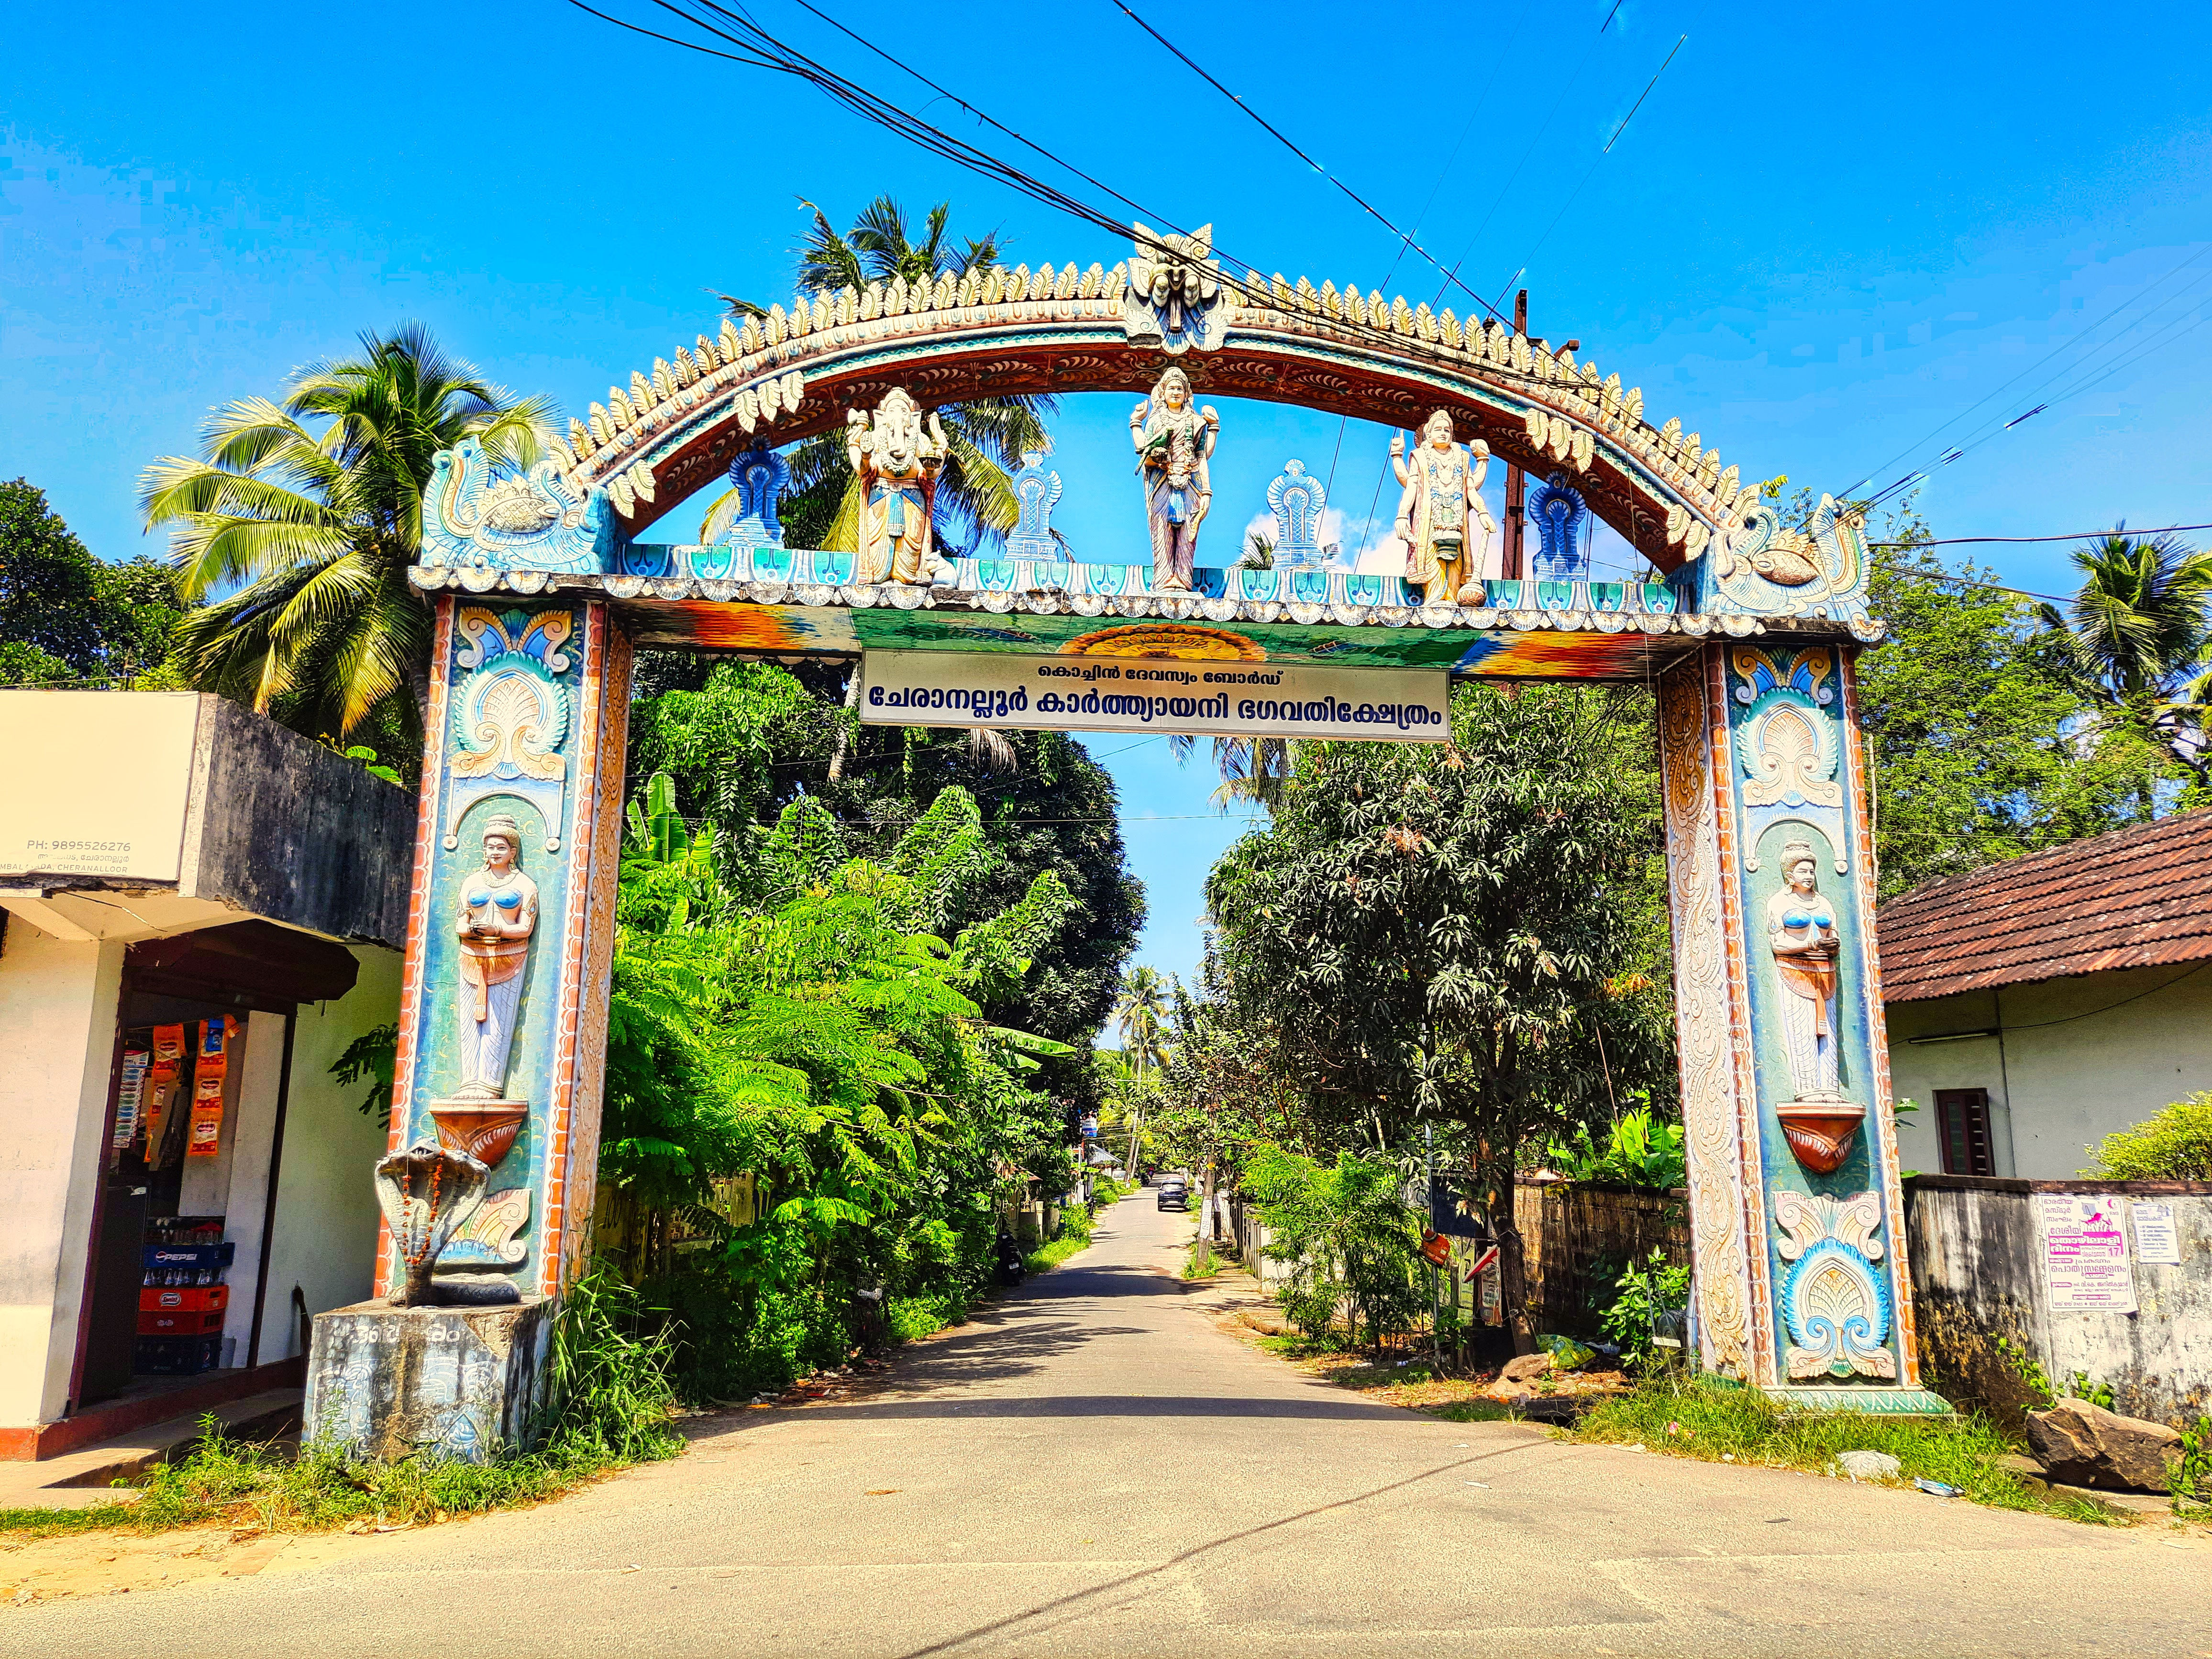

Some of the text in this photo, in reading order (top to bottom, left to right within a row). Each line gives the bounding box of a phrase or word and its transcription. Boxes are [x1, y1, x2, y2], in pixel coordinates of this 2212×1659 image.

[1038, 665, 1284, 686] കൊച്ചിൻ ദേവസ്വം ബോർഡ്
[869, 686, 1028, 718] ചേരാനല്ലൂർ
[1037, 688, 1229, 722] കാർത്ത്യായനി
[27, 840, 131, 852] PH: 9895526276
[57, 864, 128, 873] CHERANALLOOR
[2050, 1237, 2120, 1245] തൊഴിലാളി
[2109, 1247, 2120, 1257] 17
